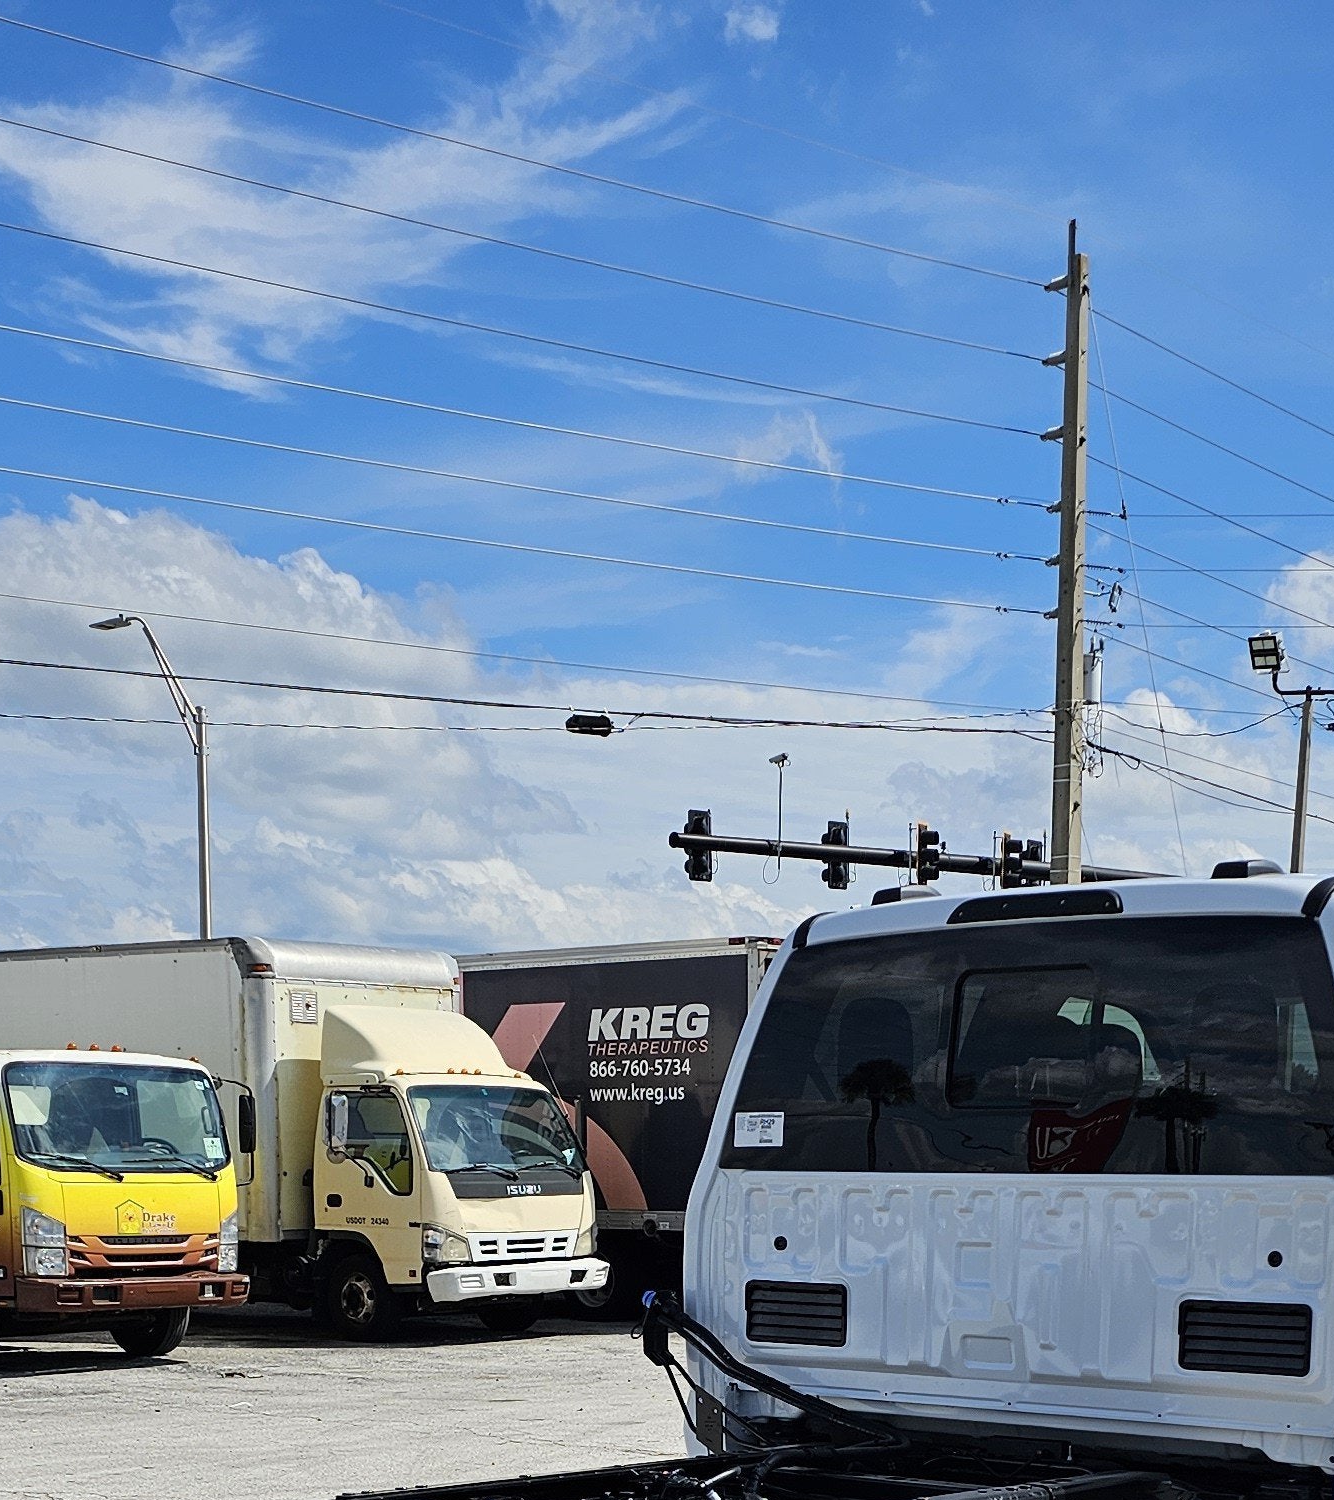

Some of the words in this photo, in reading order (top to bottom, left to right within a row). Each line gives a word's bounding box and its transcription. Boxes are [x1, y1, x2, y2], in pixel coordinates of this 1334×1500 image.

[588, 1003, 710, 1041] KREG
[588, 1040, 708, 1056] THERAPEUTICS
[589, 1058, 691, 1078] 866-760-5734
[590, 1083, 685, 1105] www.kreg.us
[506, 1184, 541, 1195] ISUZU
[143, 1213, 175, 1222] Drake
[346, 1216, 366, 1225] USDOT
